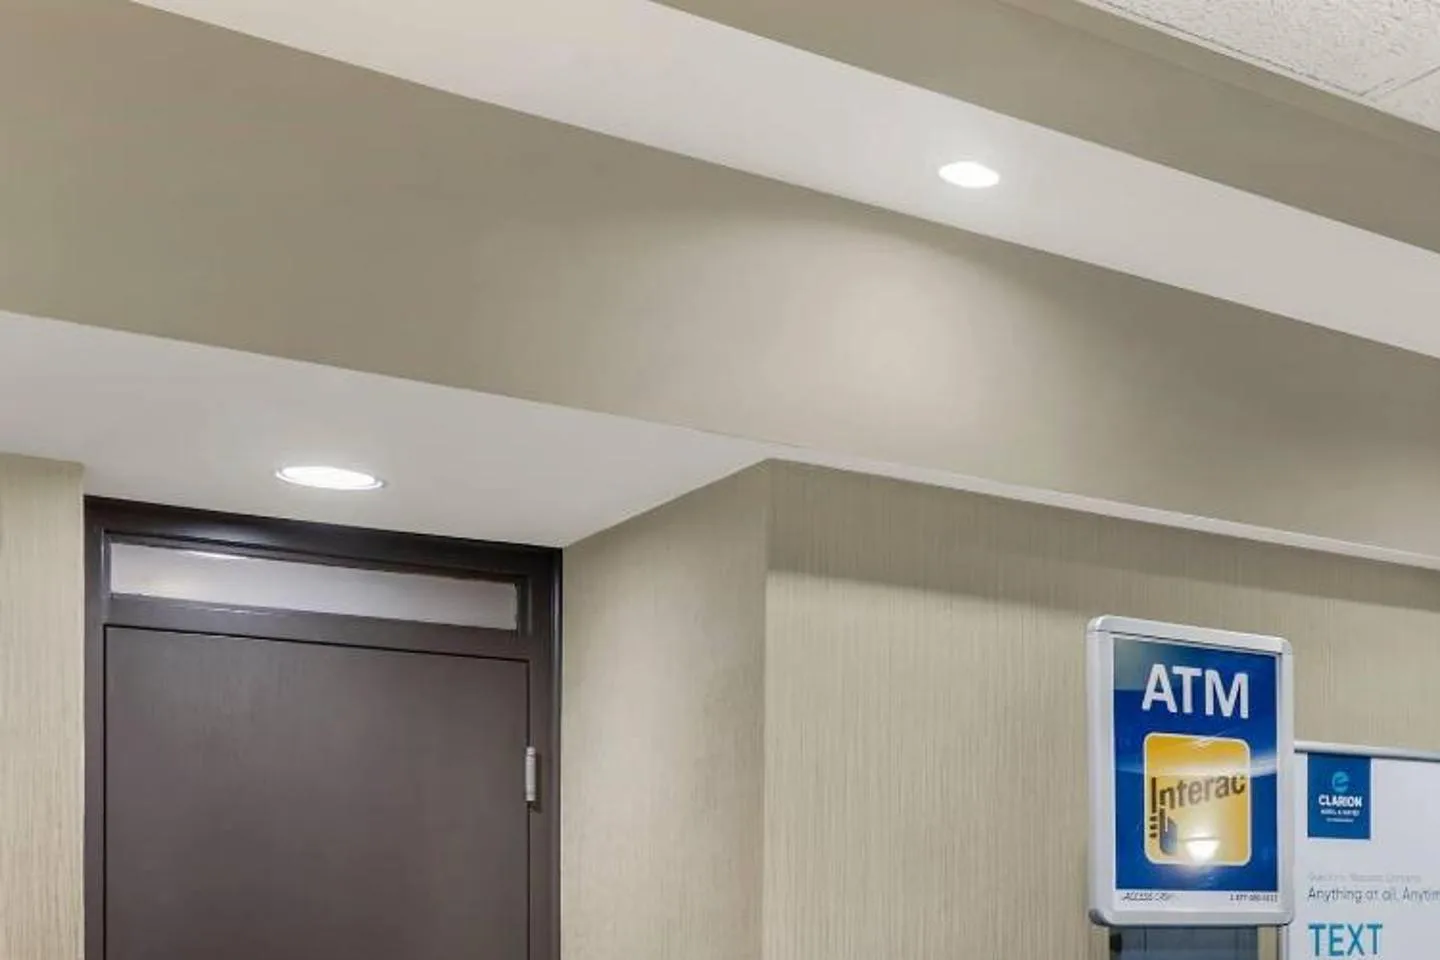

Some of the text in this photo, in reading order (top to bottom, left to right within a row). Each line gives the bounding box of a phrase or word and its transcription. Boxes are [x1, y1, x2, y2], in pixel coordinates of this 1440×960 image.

[1142, 664, 1249, 719] ATM
[1151, 774, 1246, 814] Interac
[1318, 794, 1362, 807] CLARION
[1308, 886, 1362, 903] Anything
[1364, 888, 1378, 900] at
[1308, 923, 1383, 956] TEXT
